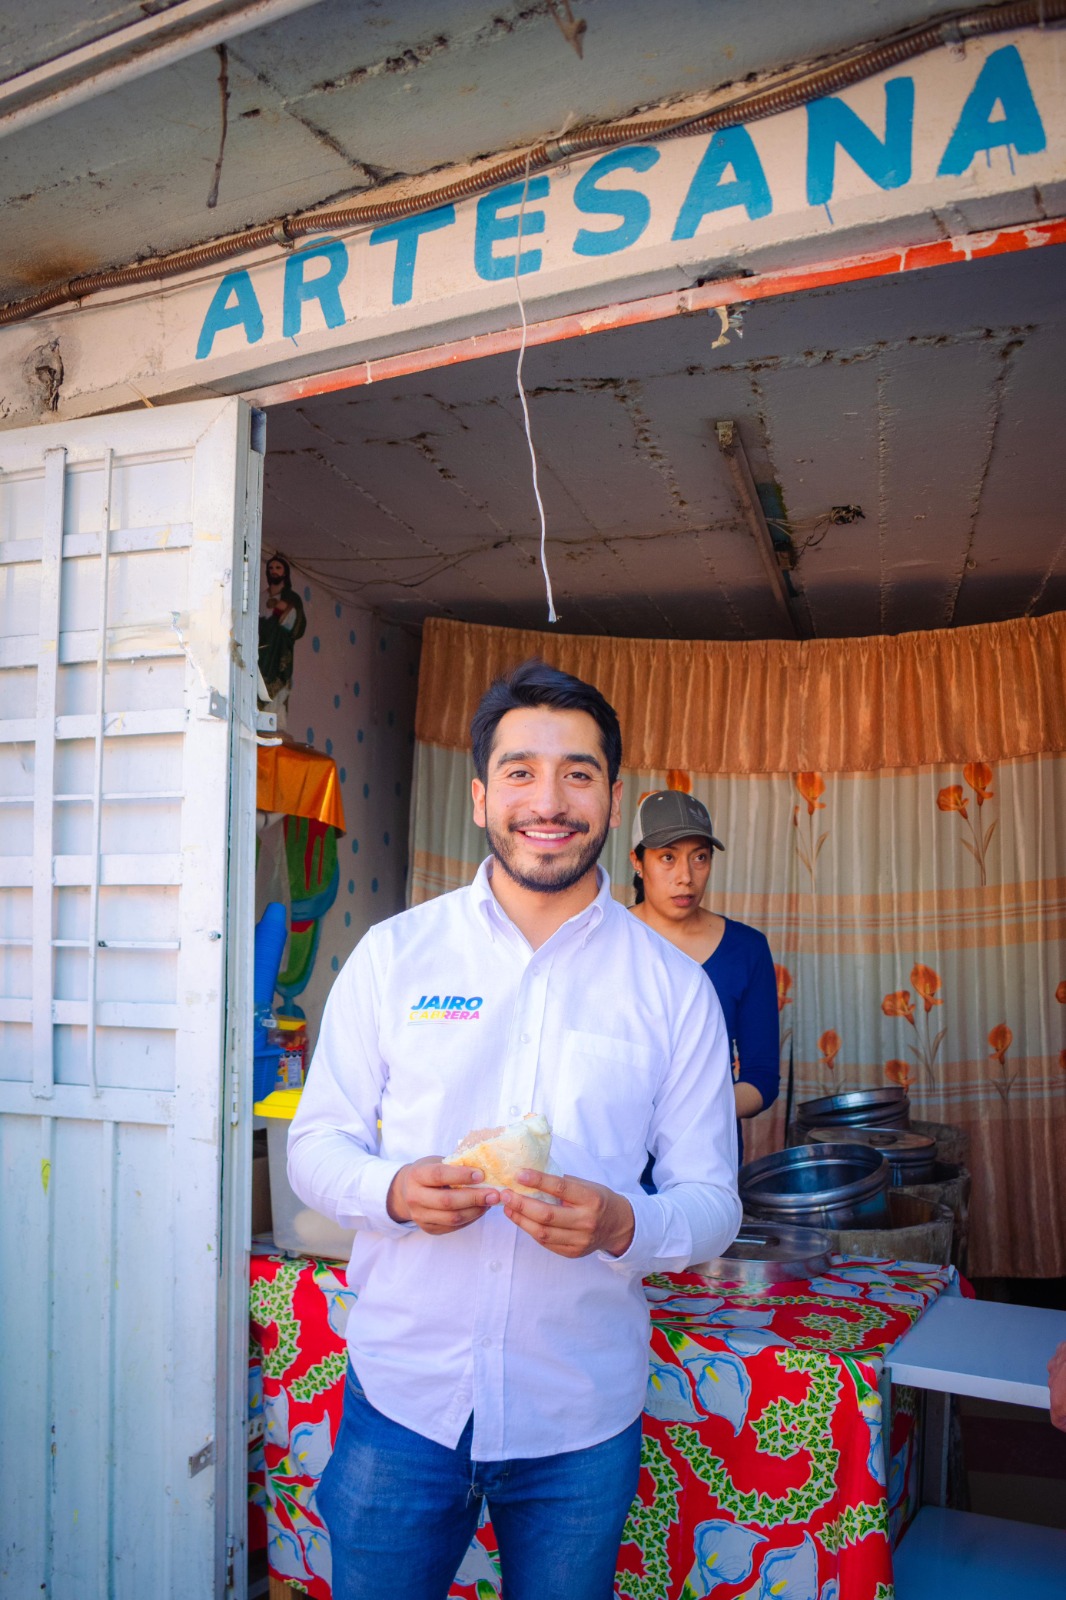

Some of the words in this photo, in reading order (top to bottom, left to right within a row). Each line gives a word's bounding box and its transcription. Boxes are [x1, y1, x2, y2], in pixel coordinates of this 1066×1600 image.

[196, 44, 1047, 359] ARTESANA
[410, 995, 484, 1011] JAIRO
[409, 1010, 480, 1021] CABRERA
